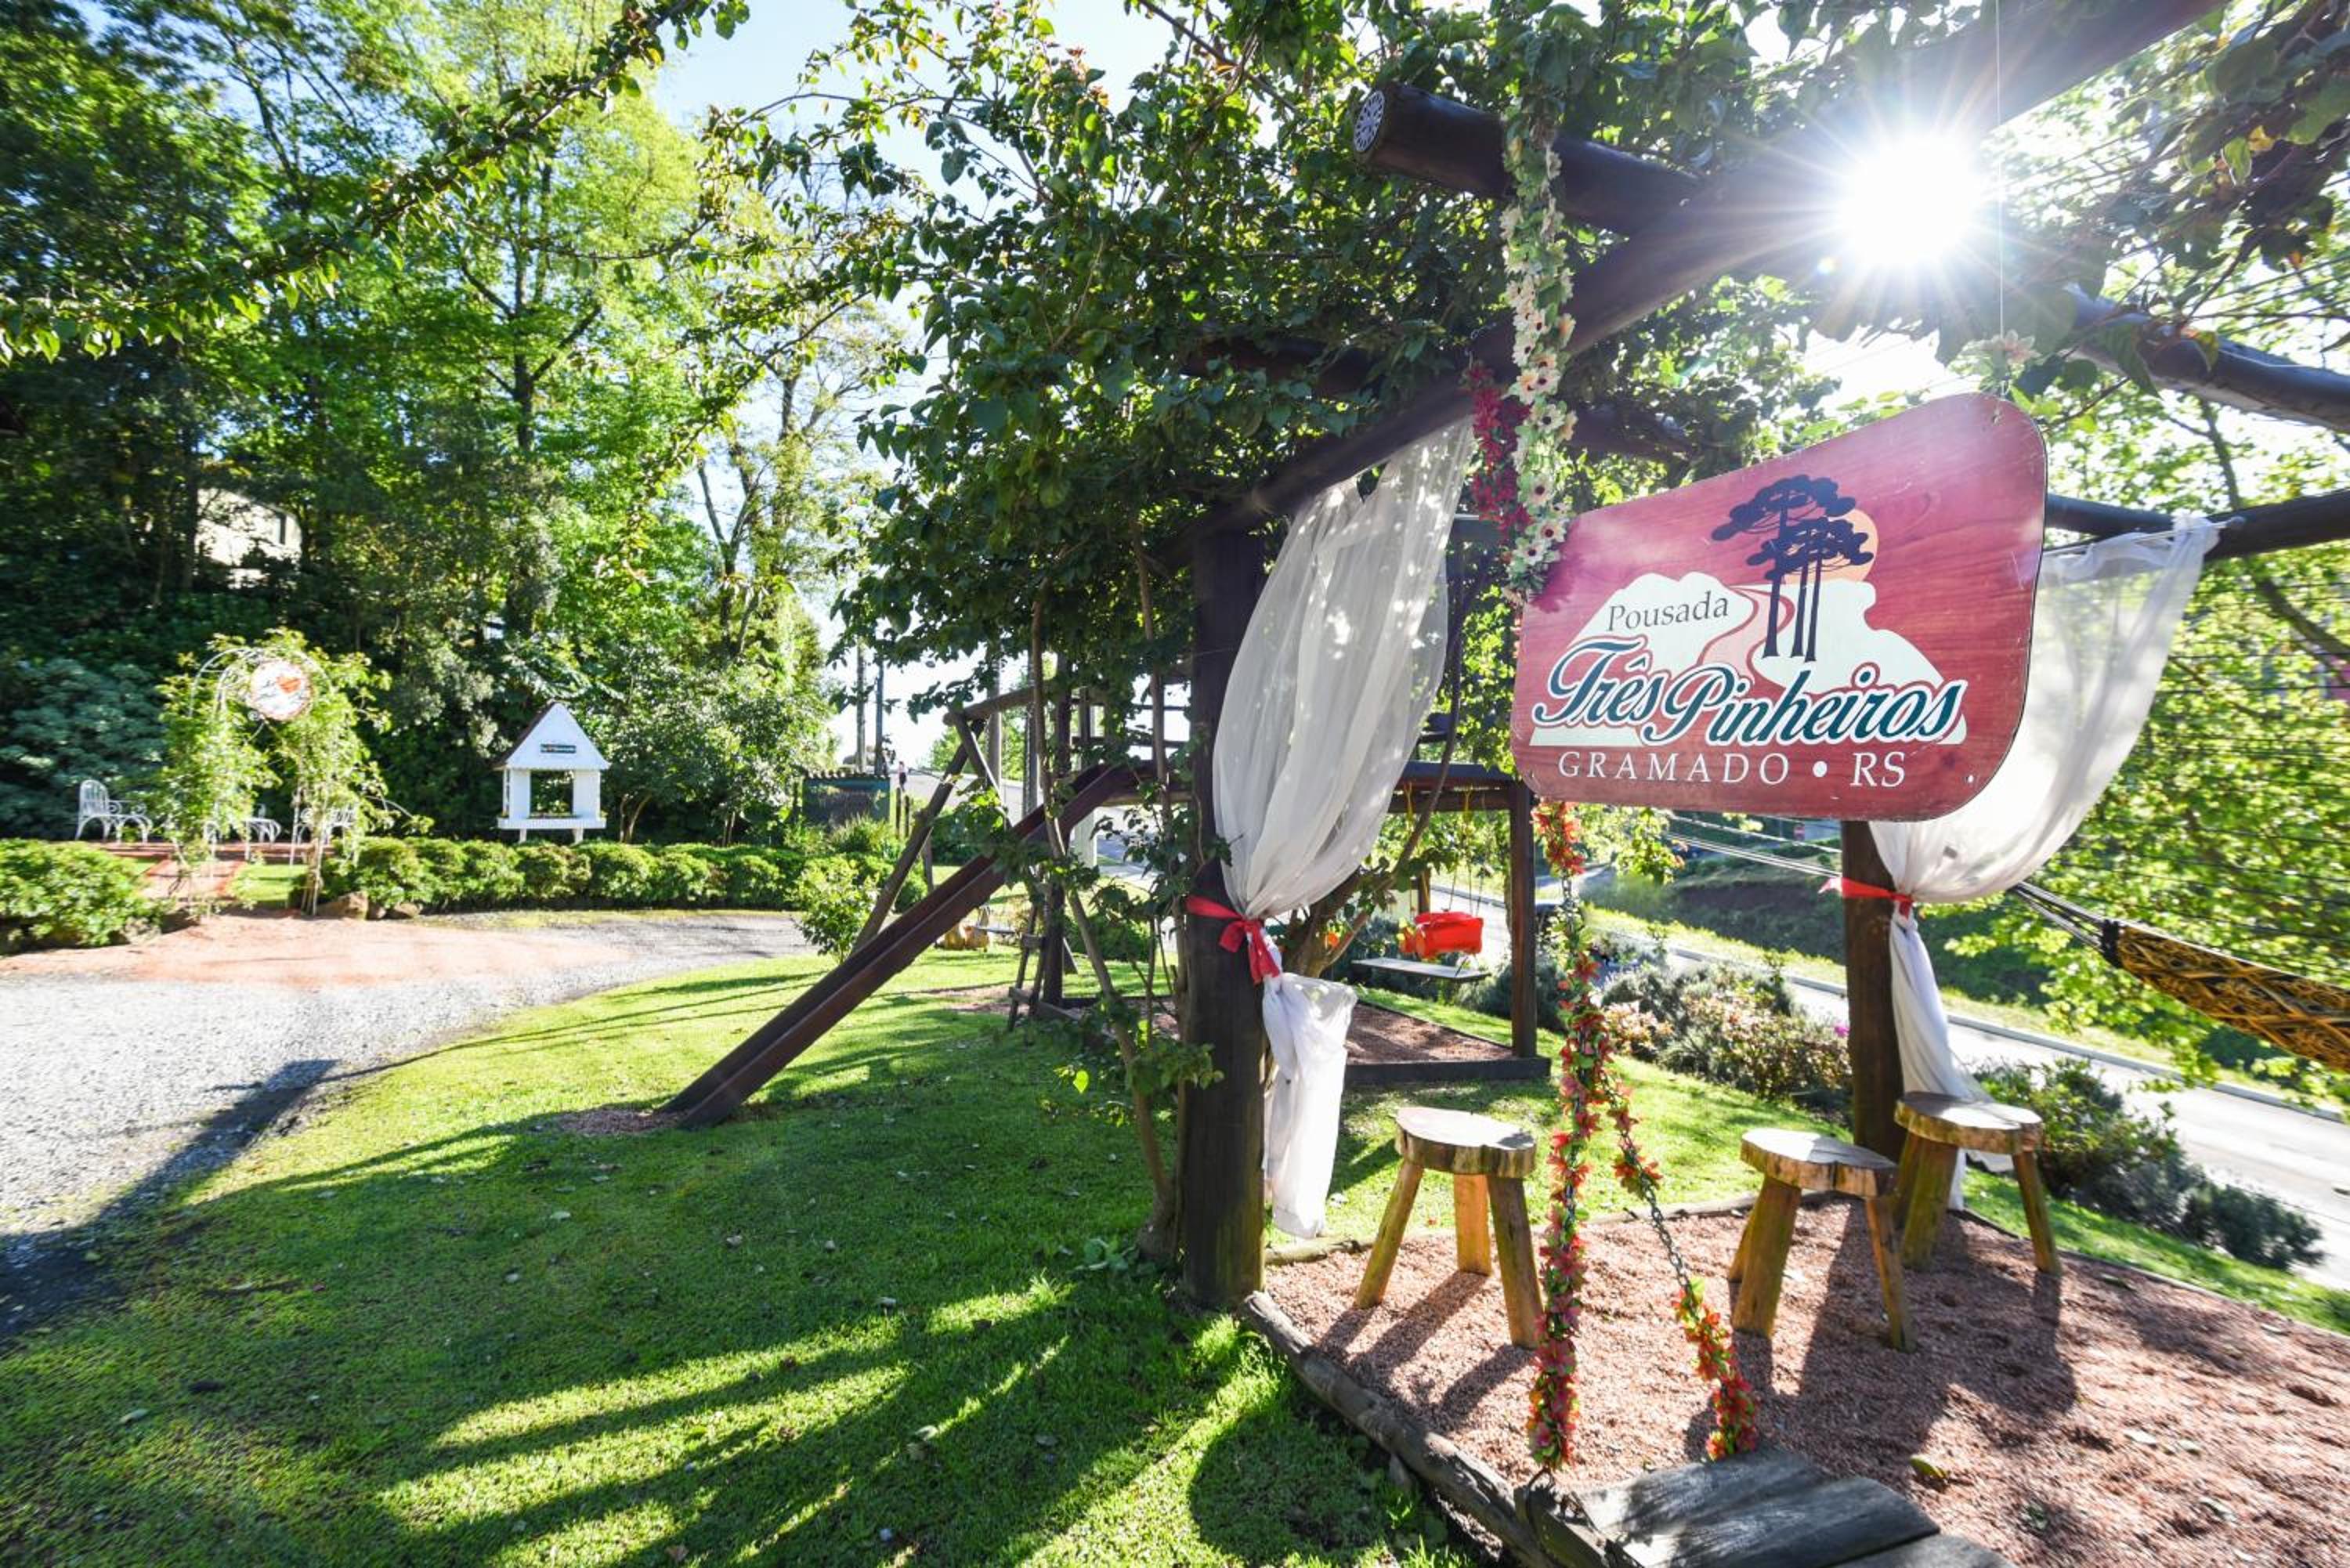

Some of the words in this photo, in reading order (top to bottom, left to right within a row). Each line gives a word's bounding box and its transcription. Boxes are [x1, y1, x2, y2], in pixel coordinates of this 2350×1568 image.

[1607, 591, 1729, 632] Pousada
[1533, 640, 1666, 724] Três
[1643, 665, 1964, 744] Pinheiros
[1559, 750, 1791, 785] GRAMADO
[1849, 750, 1906, 788] RS
